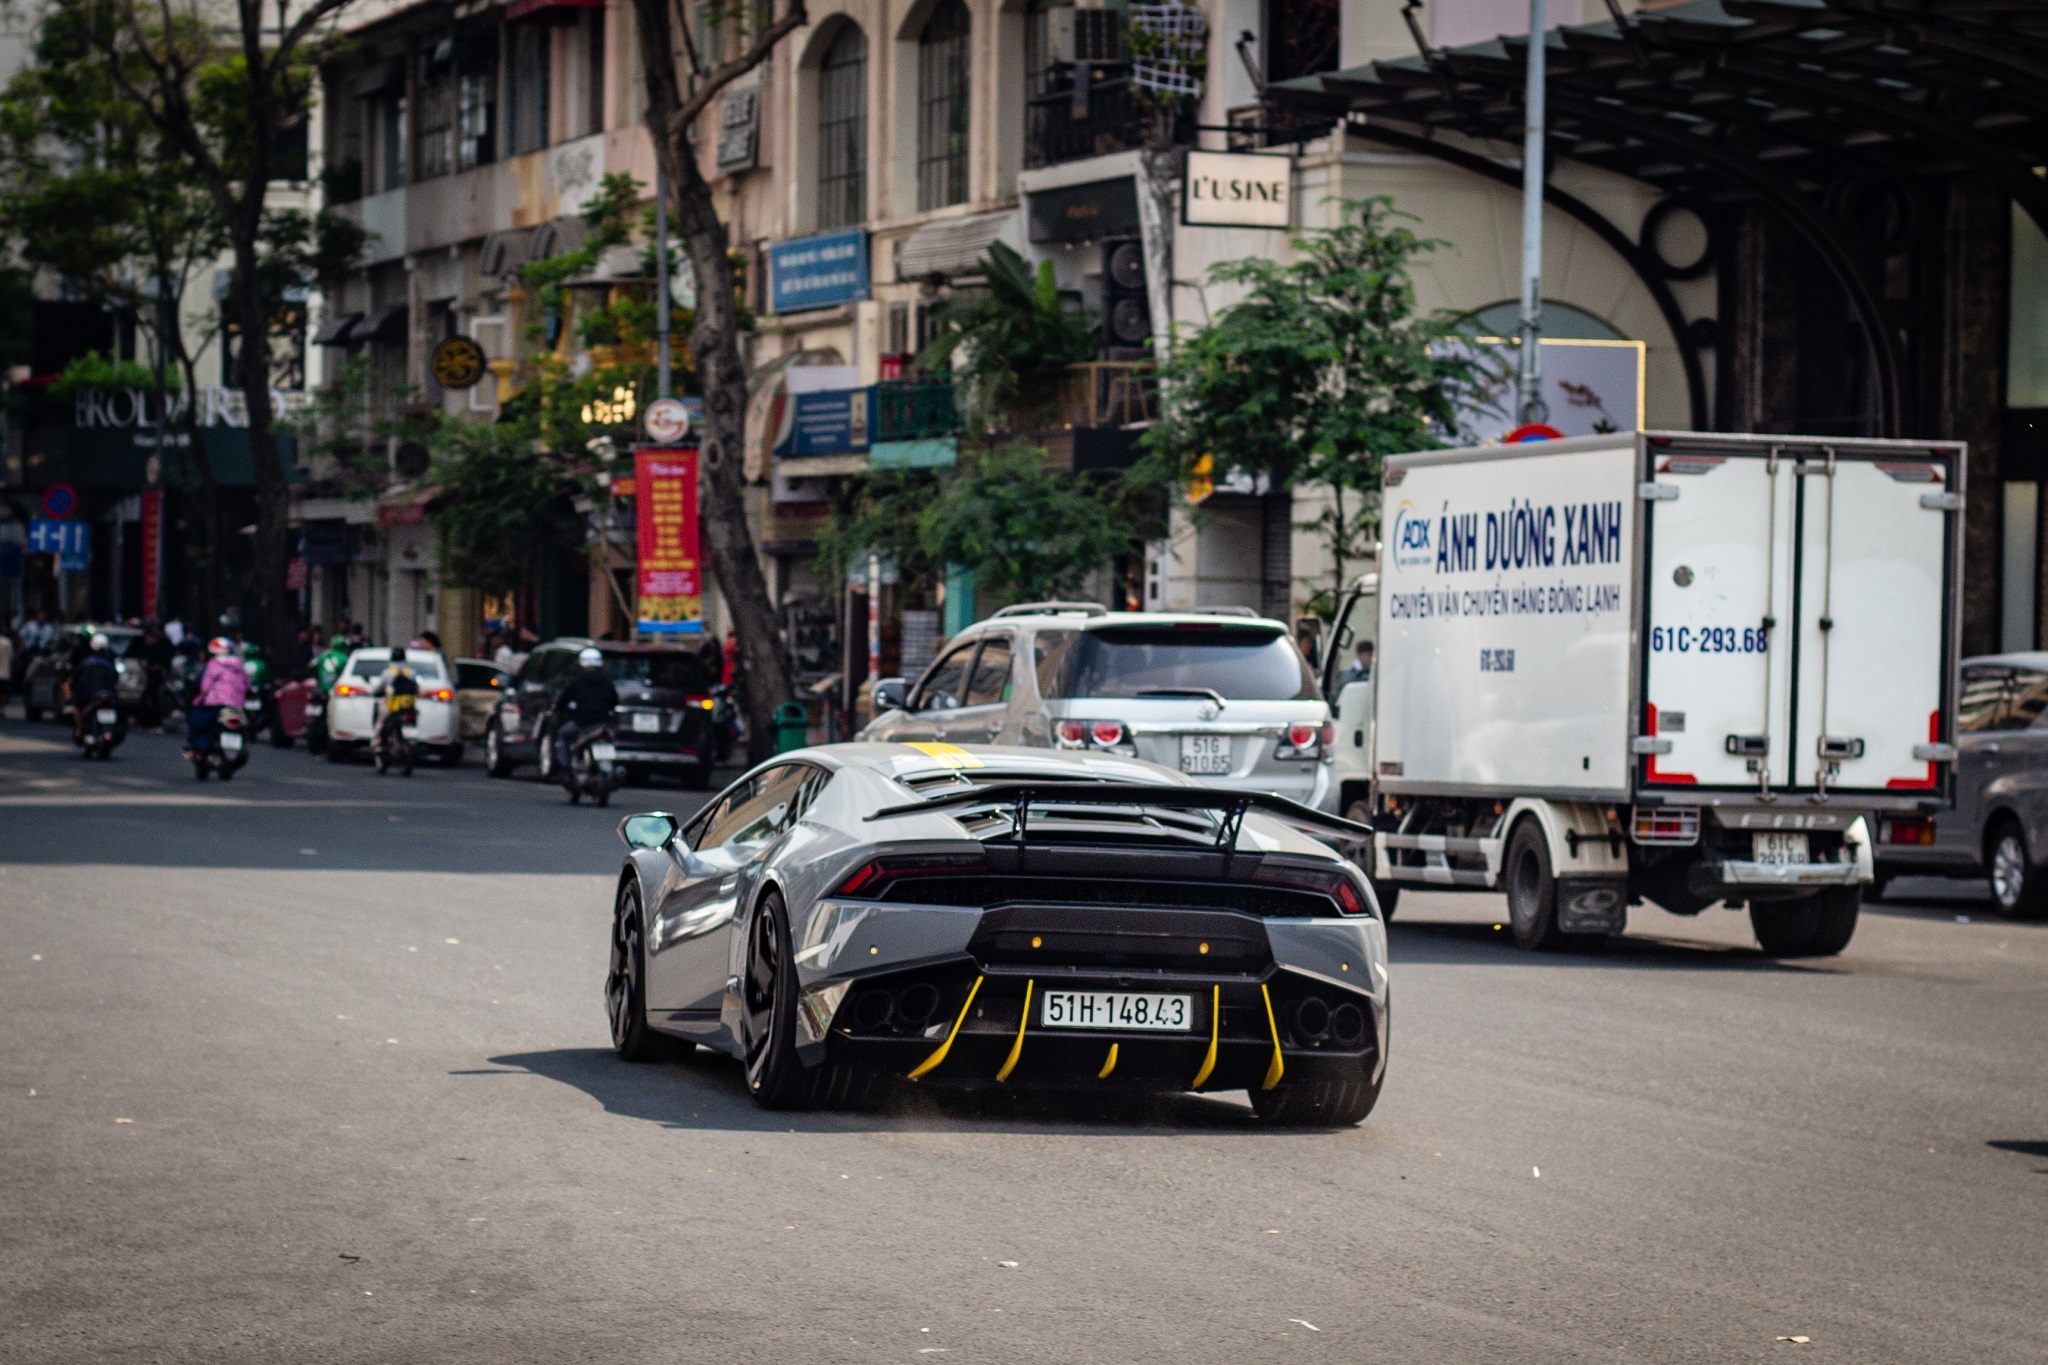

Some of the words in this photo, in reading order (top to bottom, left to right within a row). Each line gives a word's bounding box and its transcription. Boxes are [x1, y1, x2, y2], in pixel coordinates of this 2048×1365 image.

[1193, 175, 1286, 202] L'USINE
[1436, 500, 1478, 574] ÁNH
[1485, 498, 1556, 570] DƯƠNG
[1562, 501, 1622, 566] XANH
[1653, 626, 1767, 653] 61C-293.68
[1193, 736, 1219, 754] 51G
[1049, 994, 1184, 1026] 51H-148.43
